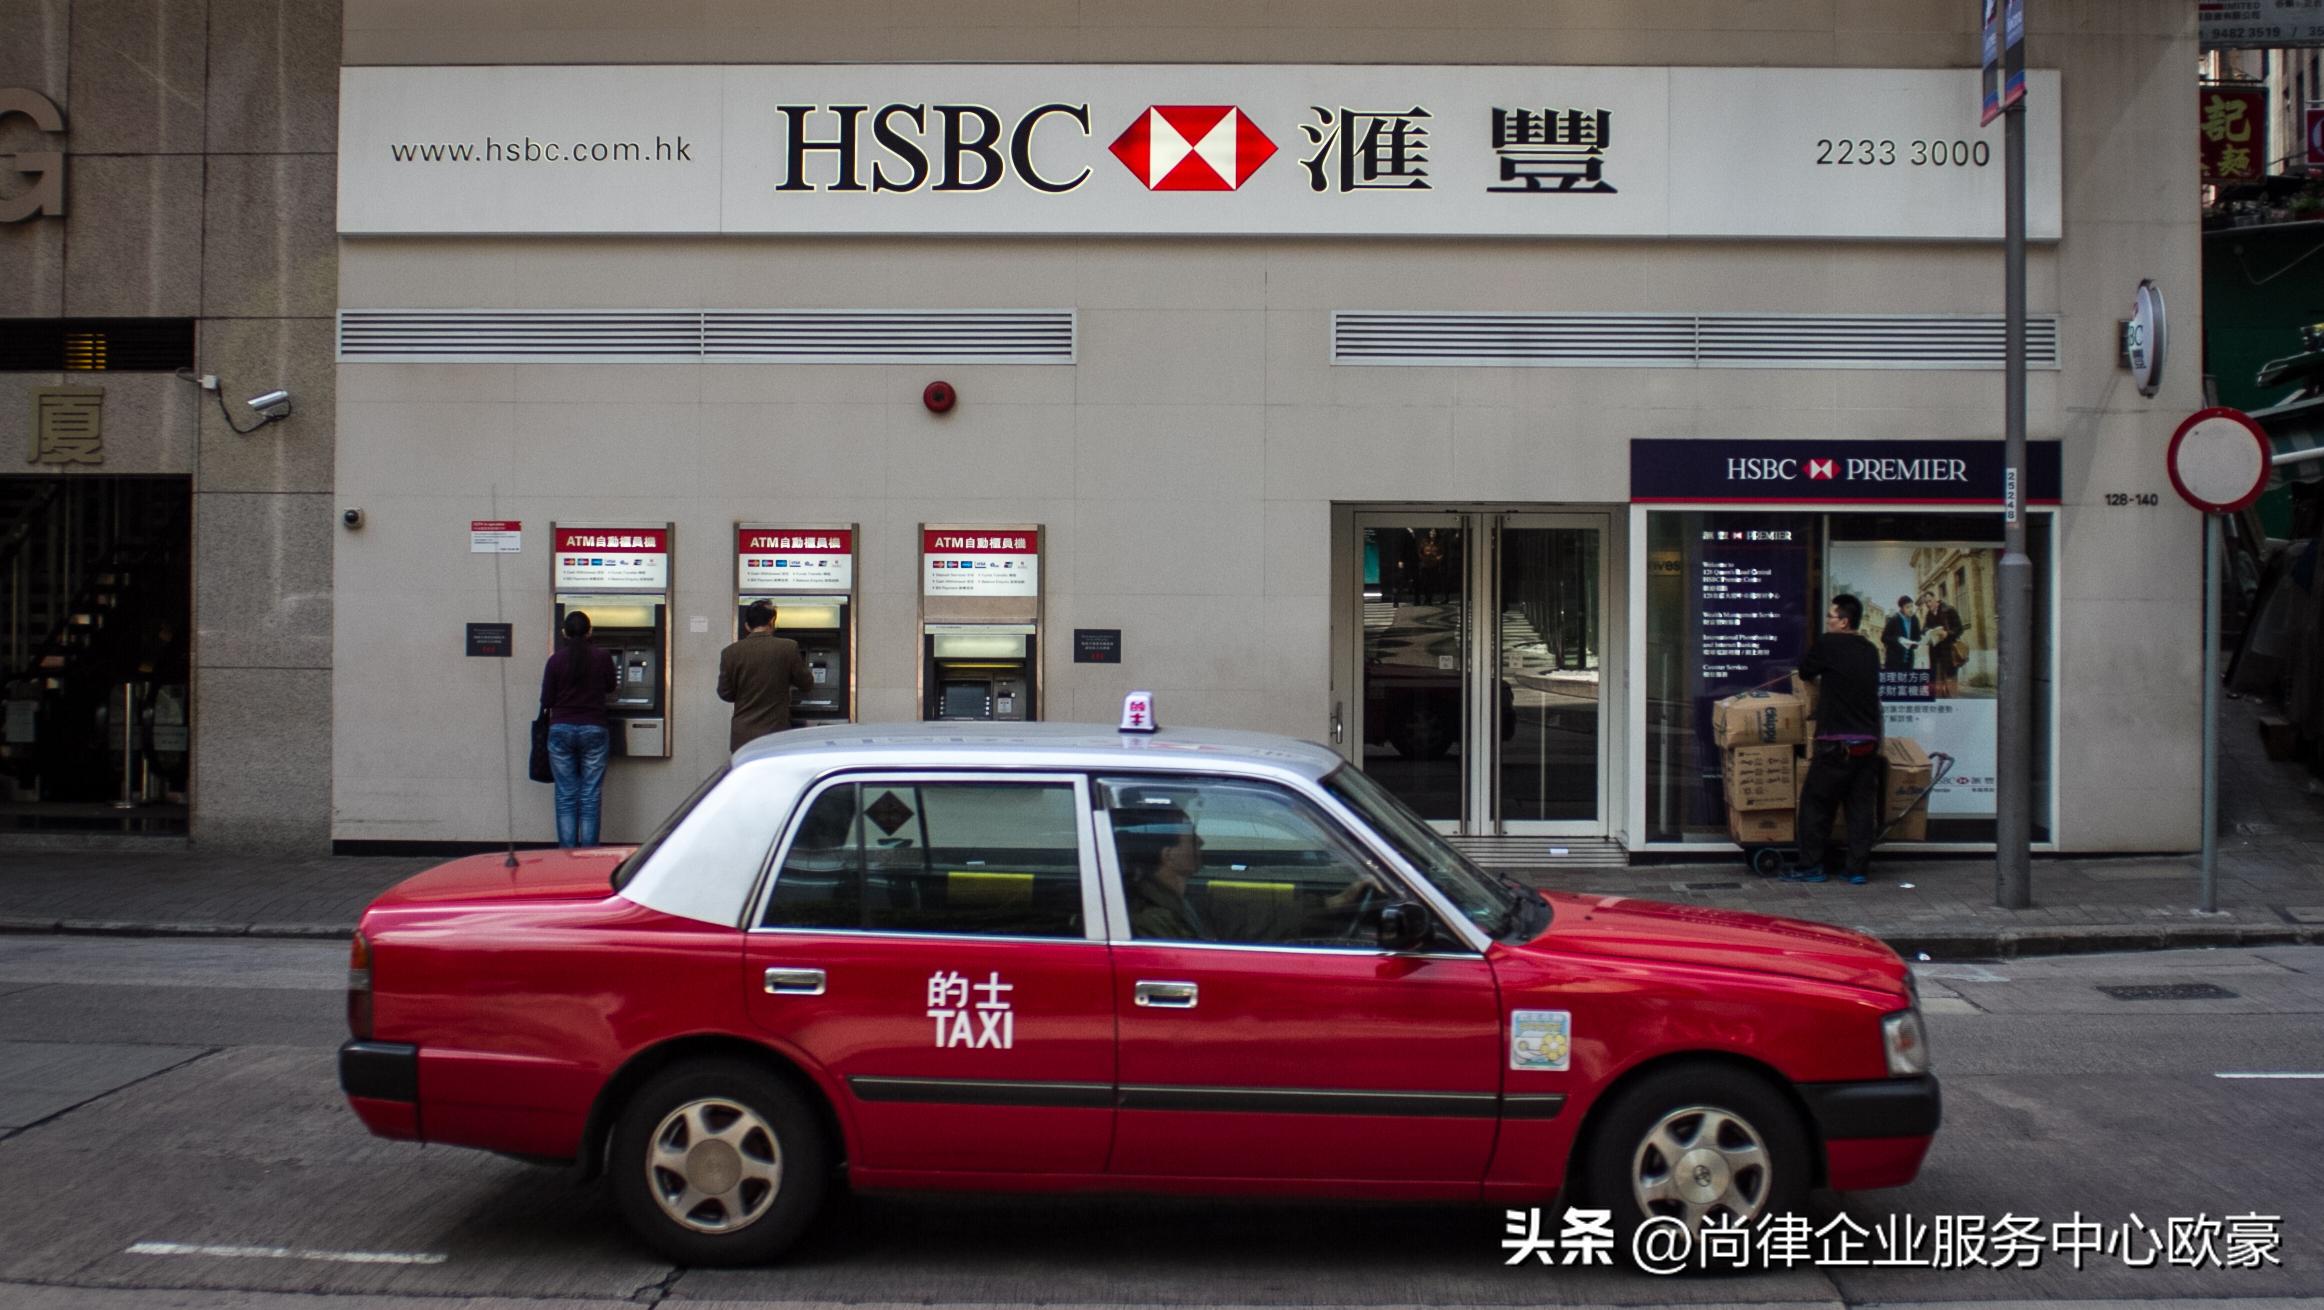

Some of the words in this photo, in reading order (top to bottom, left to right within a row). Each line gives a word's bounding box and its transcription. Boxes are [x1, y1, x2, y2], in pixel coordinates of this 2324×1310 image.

[391, 136, 691, 162] www.hsbc.com.hk
[774, 103, 1093, 193] HSBC
[1816, 139, 1895, 165] 2233
[1911, 140, 1990, 166] 3000
[1727, 458, 1797, 480] HSBC
[1846, 459, 1968, 482] PREMIER
[2007, 472, 2015, 519] 25248
[2104, 493, 2159, 506] 128-140
[1747, 531, 1792, 541] PREMIER
[927, 970, 1014, 1009] 的士
[926, 1010, 1014, 1049] TAXI
